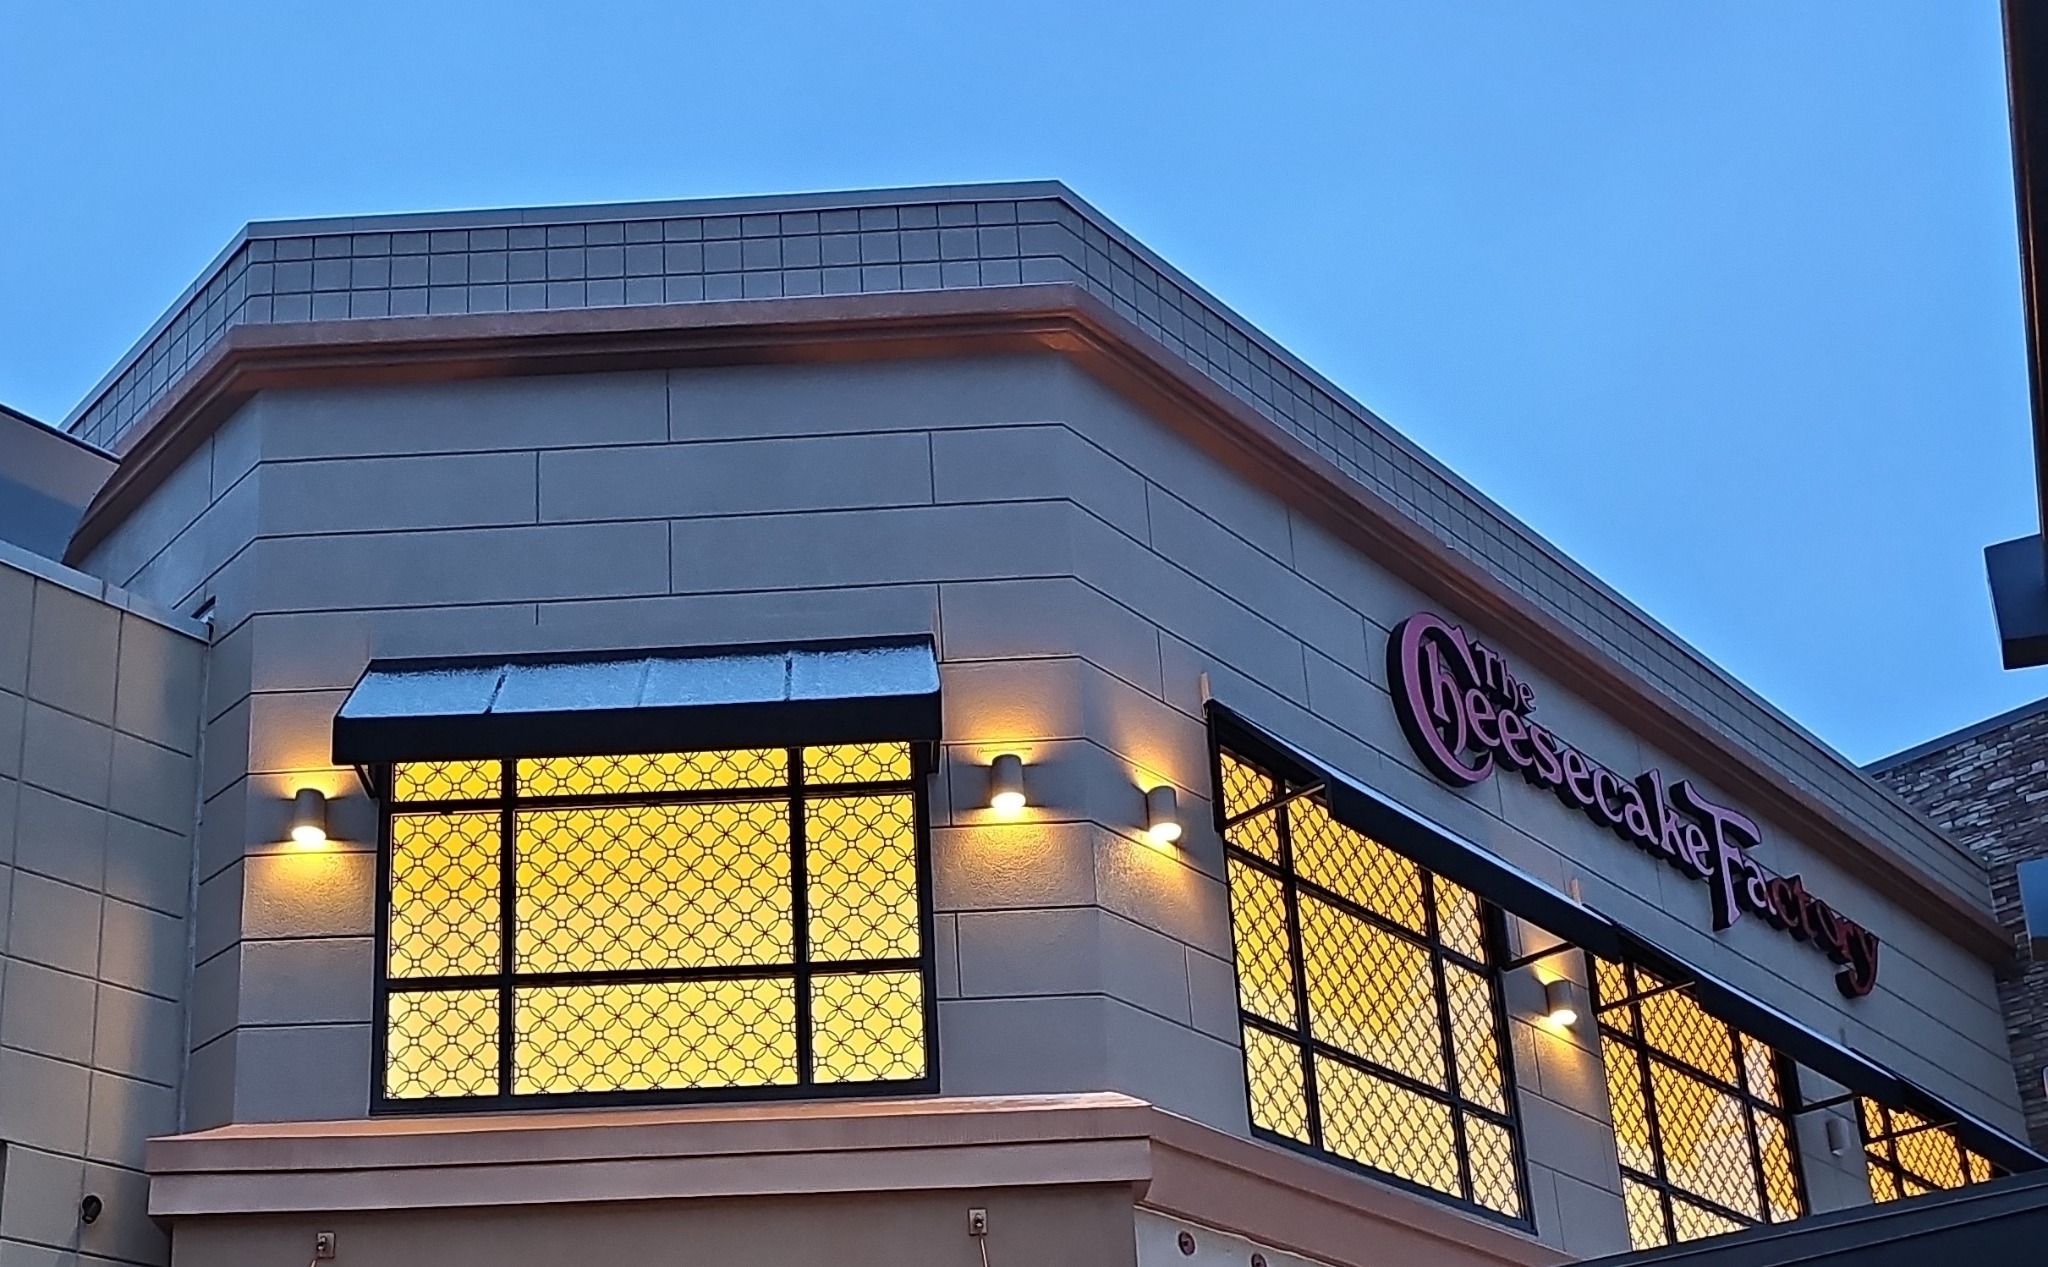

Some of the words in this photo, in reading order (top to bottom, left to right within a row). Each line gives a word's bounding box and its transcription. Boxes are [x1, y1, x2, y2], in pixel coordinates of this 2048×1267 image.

[1475, 642, 1537, 712] The
[1388, 612, 1715, 877] Cheesecake
[1672, 780, 1880, 998] Factory
